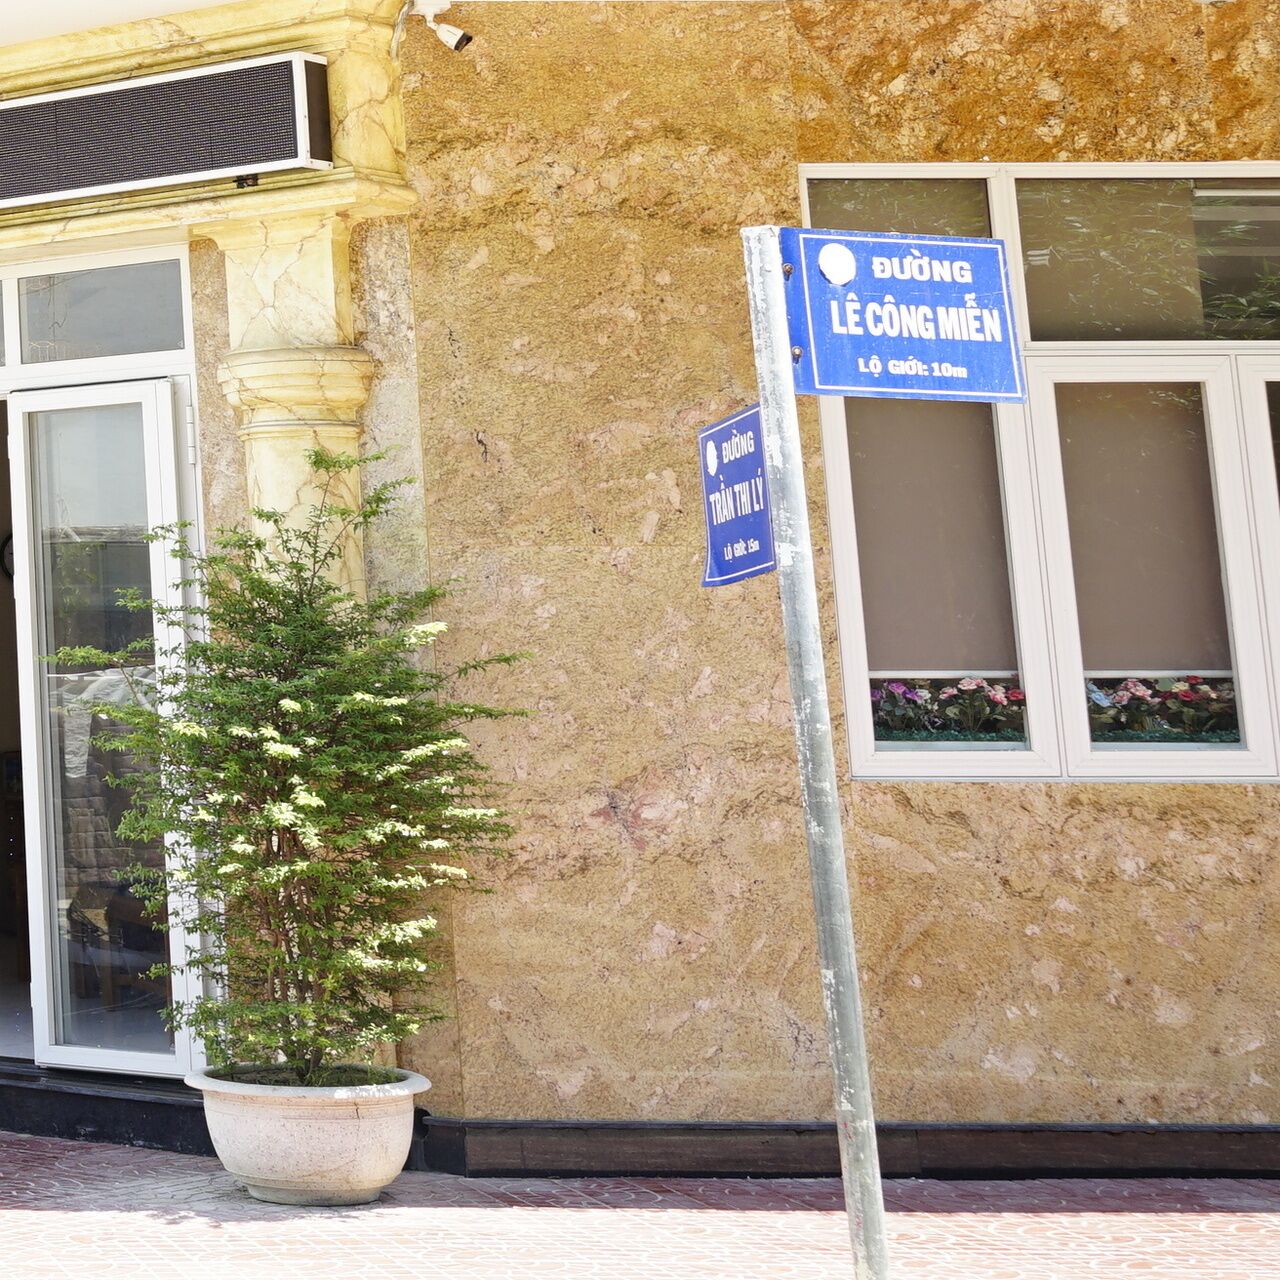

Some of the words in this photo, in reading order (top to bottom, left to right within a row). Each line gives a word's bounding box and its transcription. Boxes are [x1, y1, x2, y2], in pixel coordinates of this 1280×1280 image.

[872, 248, 973, 284] ĐƯỜNG
[830, 292, 863, 336] LÊ
[864, 294, 938, 340] CÔNG
[939, 292, 1002, 342] MIỄN
[858, 355, 881, 378] LỘ
[931, 361, 968, 378] 10m
[721, 427, 755, 464] ĐƯỜNG
[709, 474, 736, 526] TRẦN
[751, 468, 764, 512] LÝ
